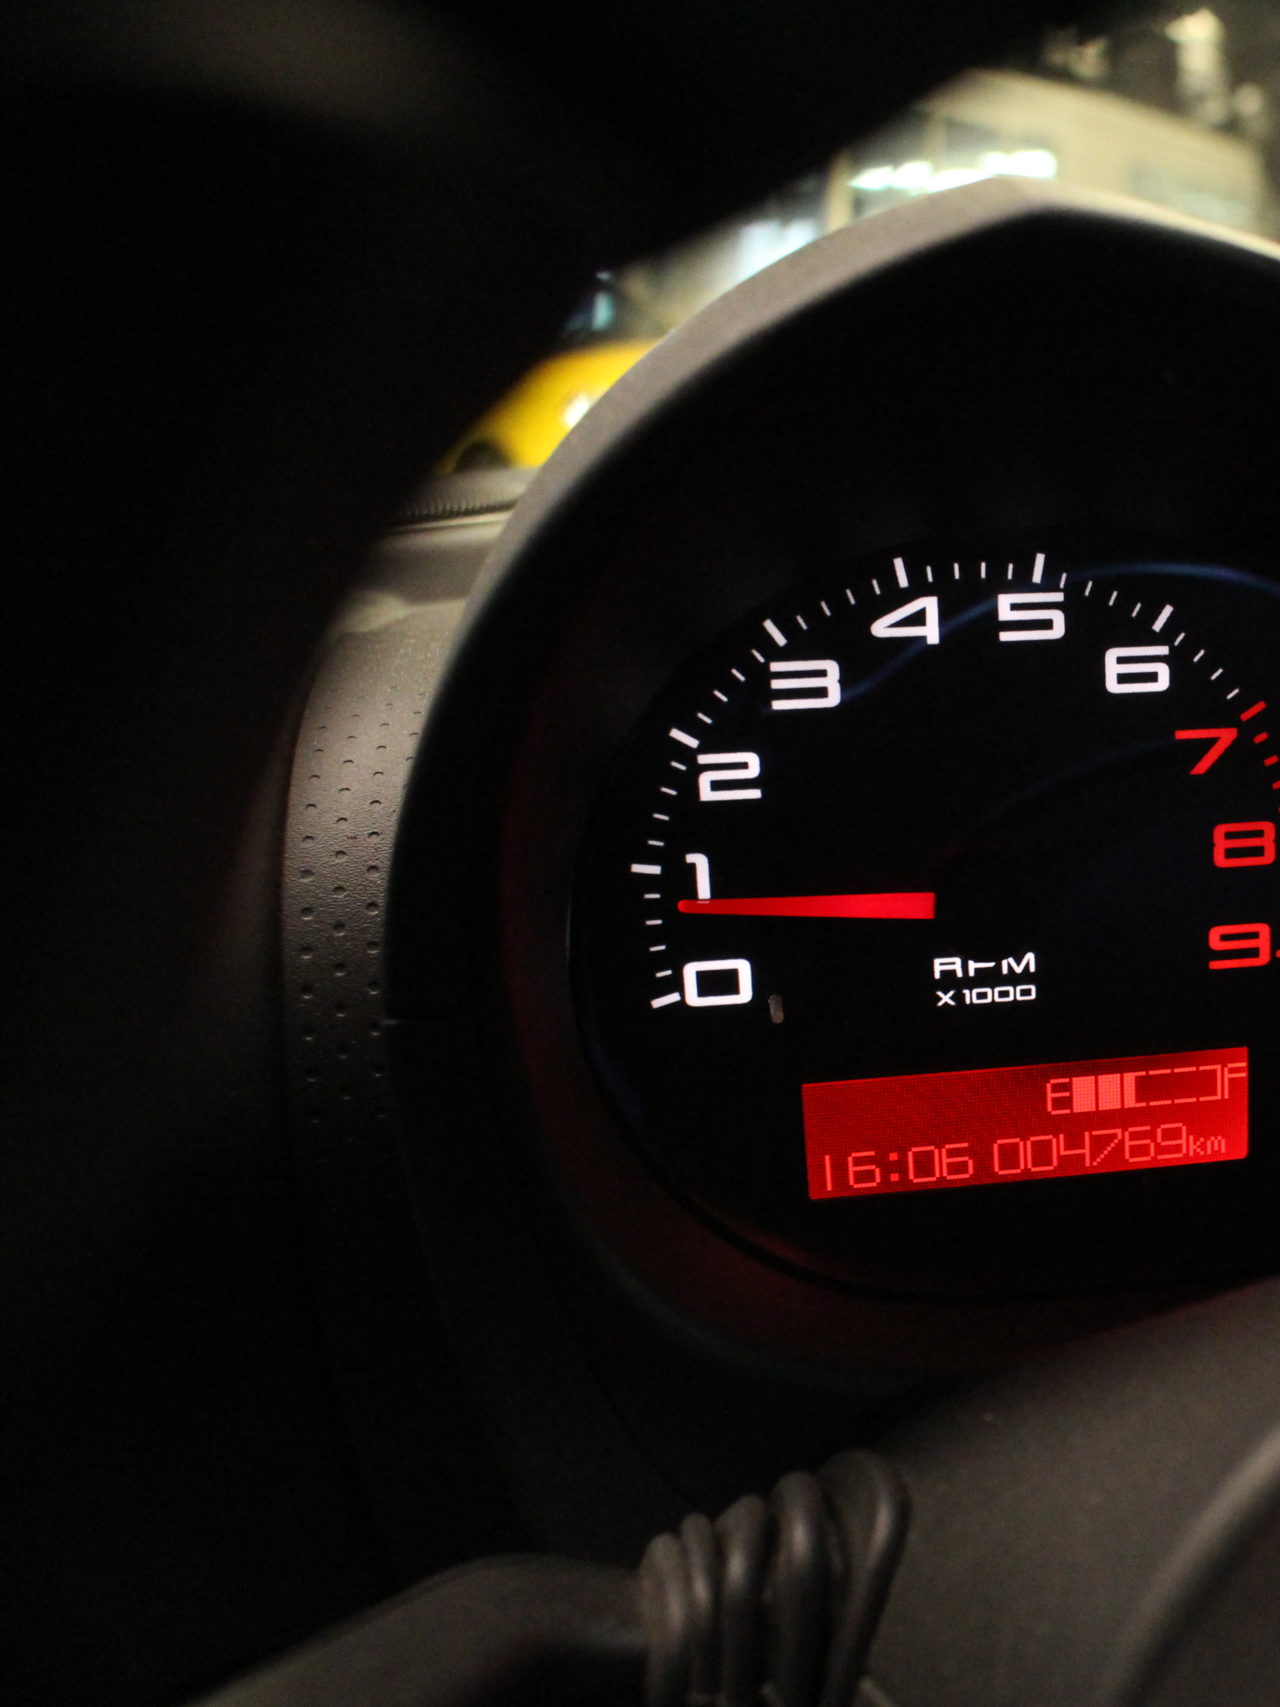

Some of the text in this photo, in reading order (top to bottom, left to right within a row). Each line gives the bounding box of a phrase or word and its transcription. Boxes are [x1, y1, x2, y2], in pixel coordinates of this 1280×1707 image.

[871, 596, 939, 644] 4
[998, 592, 1065, 641] 5
[770, 660, 841, 710] 3
[1105, 646, 1170, 694] 6
[1175, 728, 1237, 774] 7
[697, 752, 761, 801] 2
[1213, 821, 1276, 868] 8
[686, 853, 711, 903] 1
[1208, 923, 1271, 969] 9
[683, 959, 753, 1007] 0
[1046, 1078, 1071, 1115] E
[1223, 1062, 1247, 1100] F
[824, 1142, 974, 1191] 16:06
